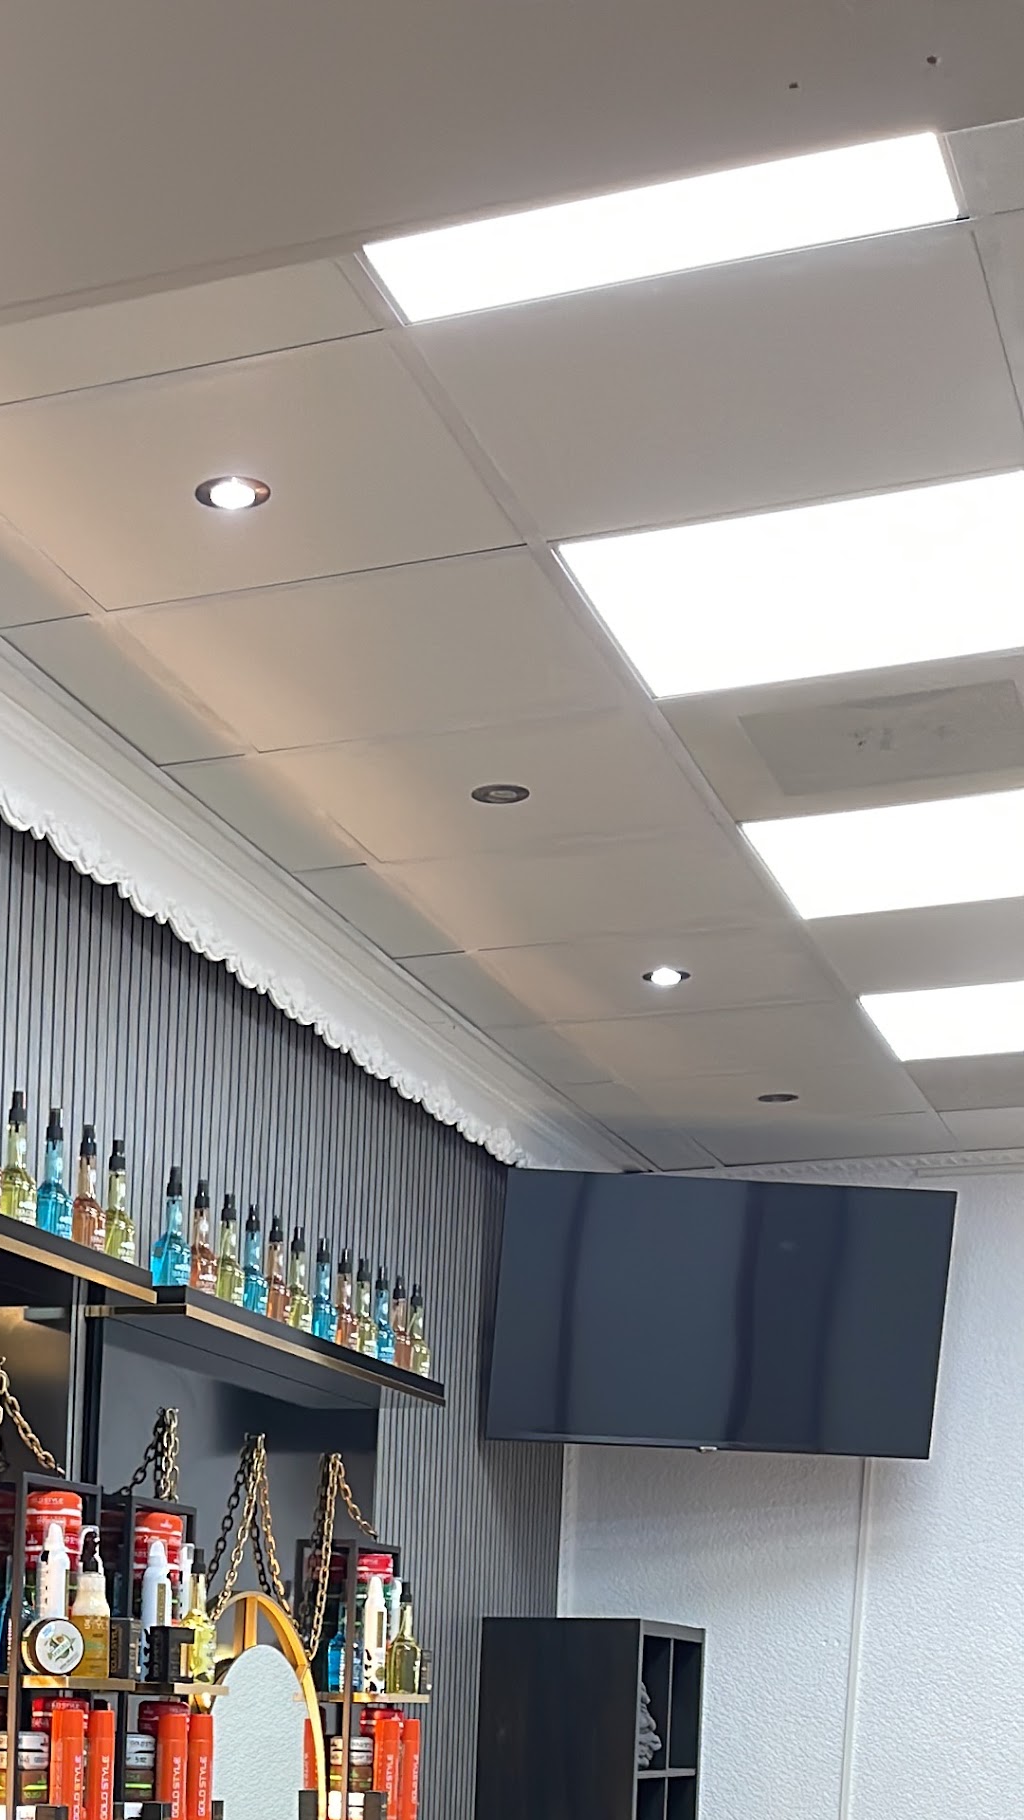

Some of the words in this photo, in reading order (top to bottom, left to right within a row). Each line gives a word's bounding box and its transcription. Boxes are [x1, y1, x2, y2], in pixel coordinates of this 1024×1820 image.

[74, 1756, 82, 1790] STYLE
[101, 1755, 110, 1789] STYLE
[172, 1756, 182, 1788] STYLE
[199, 1756, 208, 1788] STYLE
[100, 1791, 108, 1820] GOLD
[171, 1790, 180, 1818] GOLD
[198, 1789, 206, 1816] GOLD
